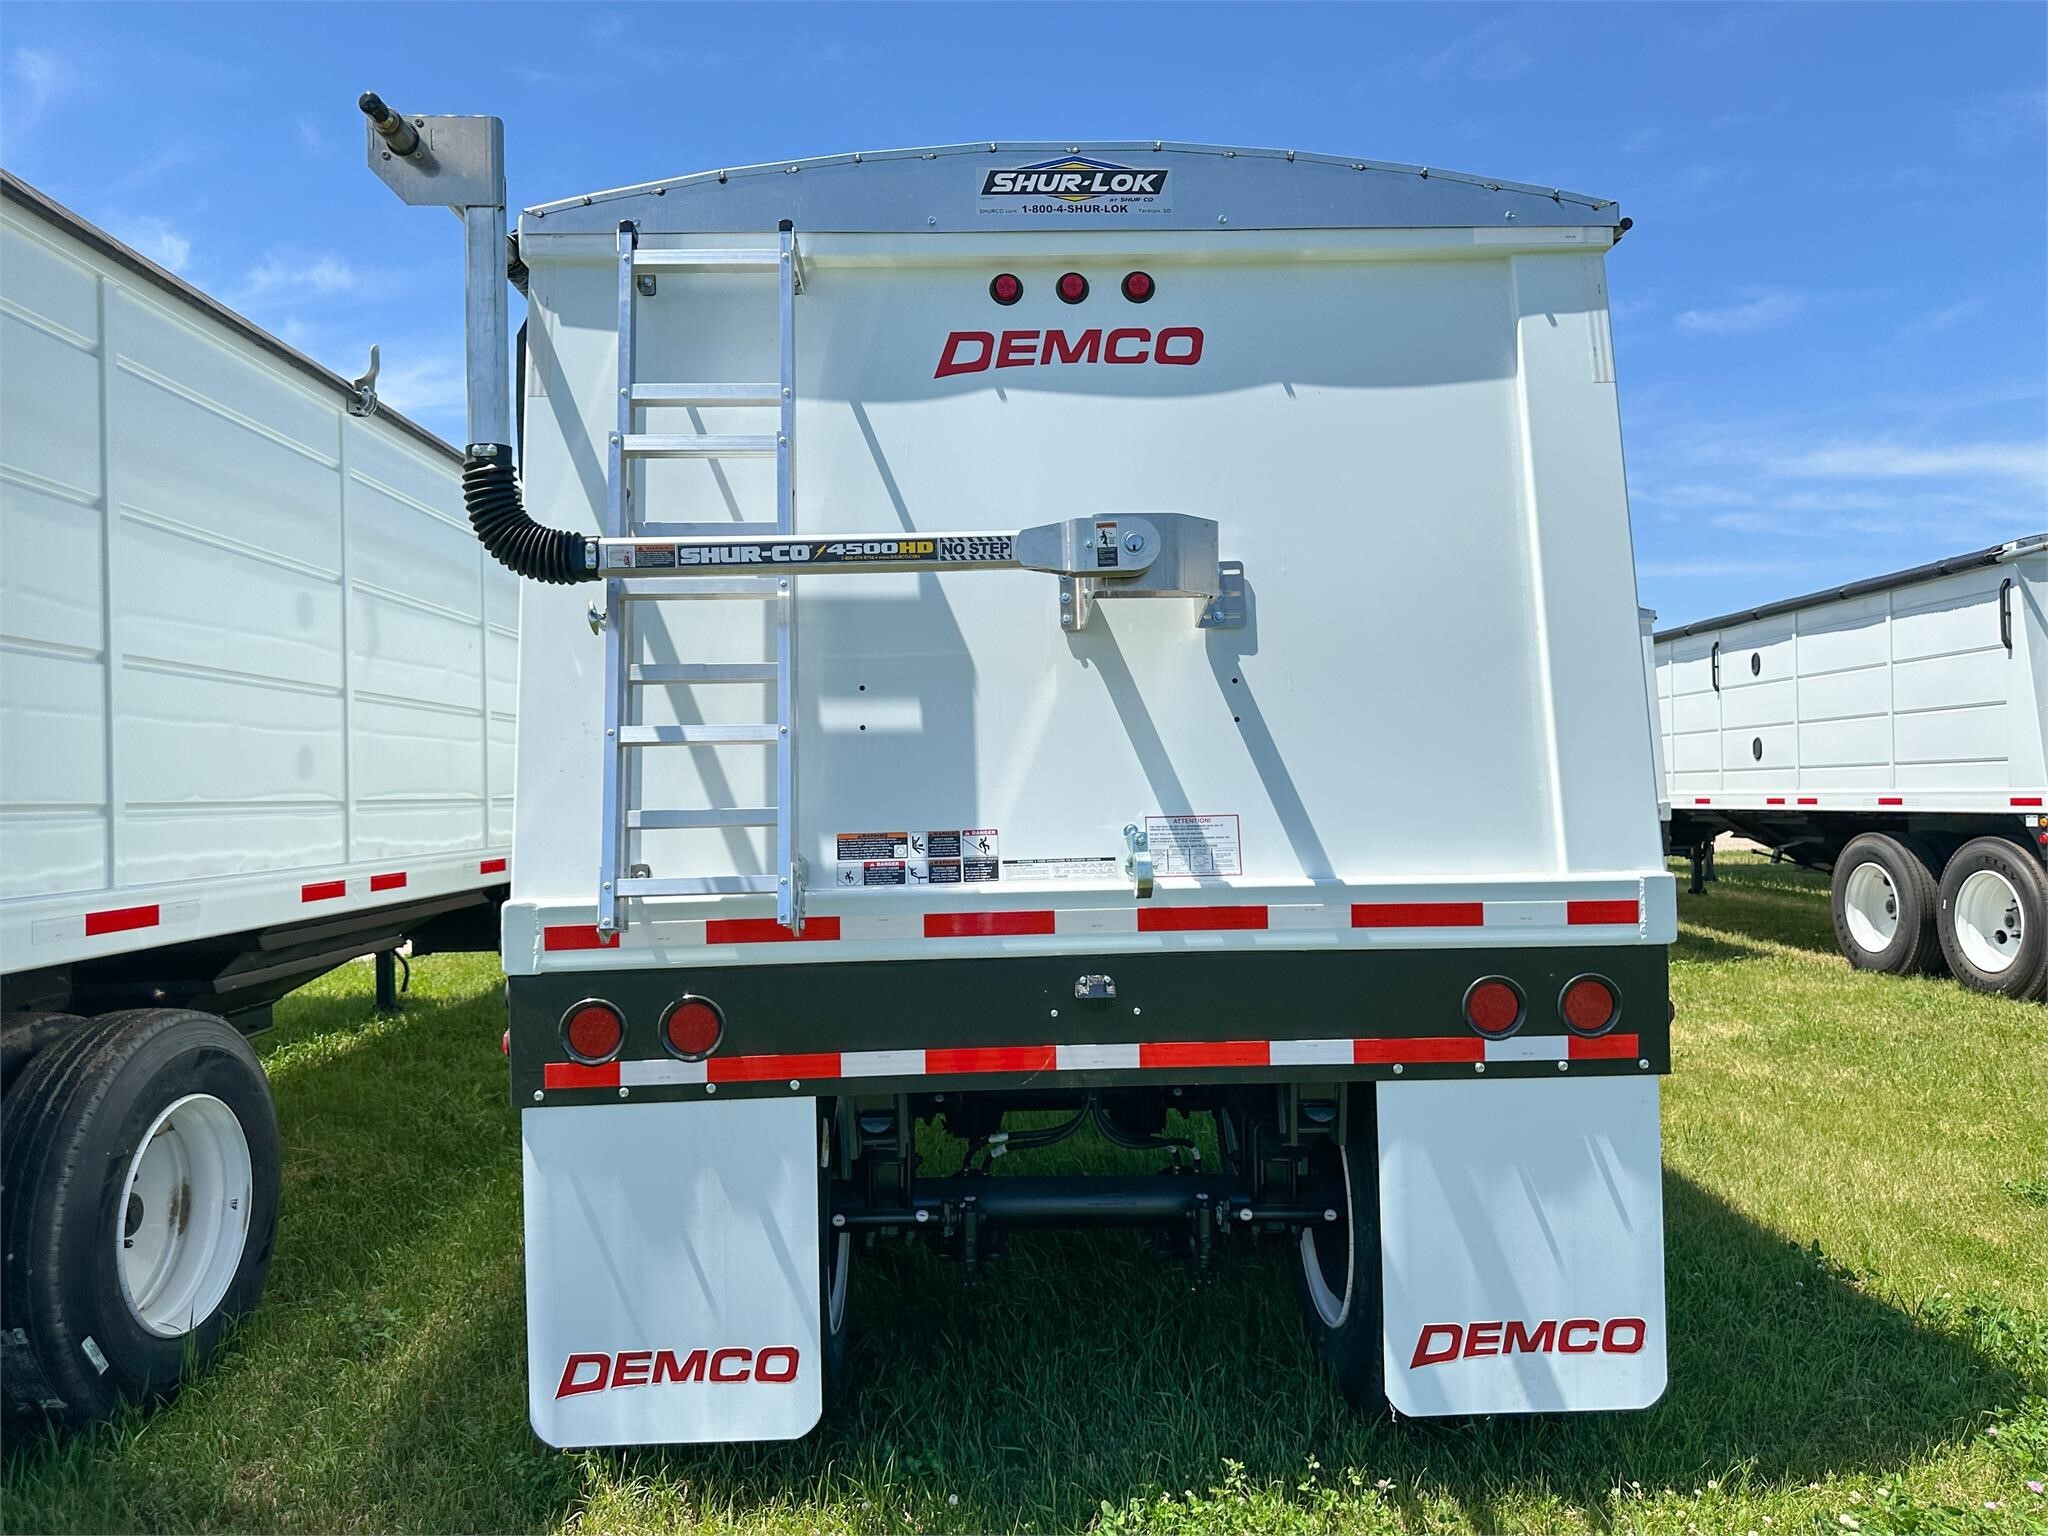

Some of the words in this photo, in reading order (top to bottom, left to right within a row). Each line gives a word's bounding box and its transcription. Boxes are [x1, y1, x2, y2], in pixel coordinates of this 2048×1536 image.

[990, 172, 1159, 193] SHUR-LOK
[1022, 204, 1129, 214] 1-800-4-SHUR-LOK
[934, 326, 1204, 379] DEMCO
[680, 544, 811, 564] SHUR-CO
[827, 541, 934, 556] 4500HD
[941, 543, 966, 556] NO
[969, 541, 1010, 555] STEP
[1409, 1317, 1646, 1369] DEMCO
[554, 1346, 800, 1400] DEMCO
